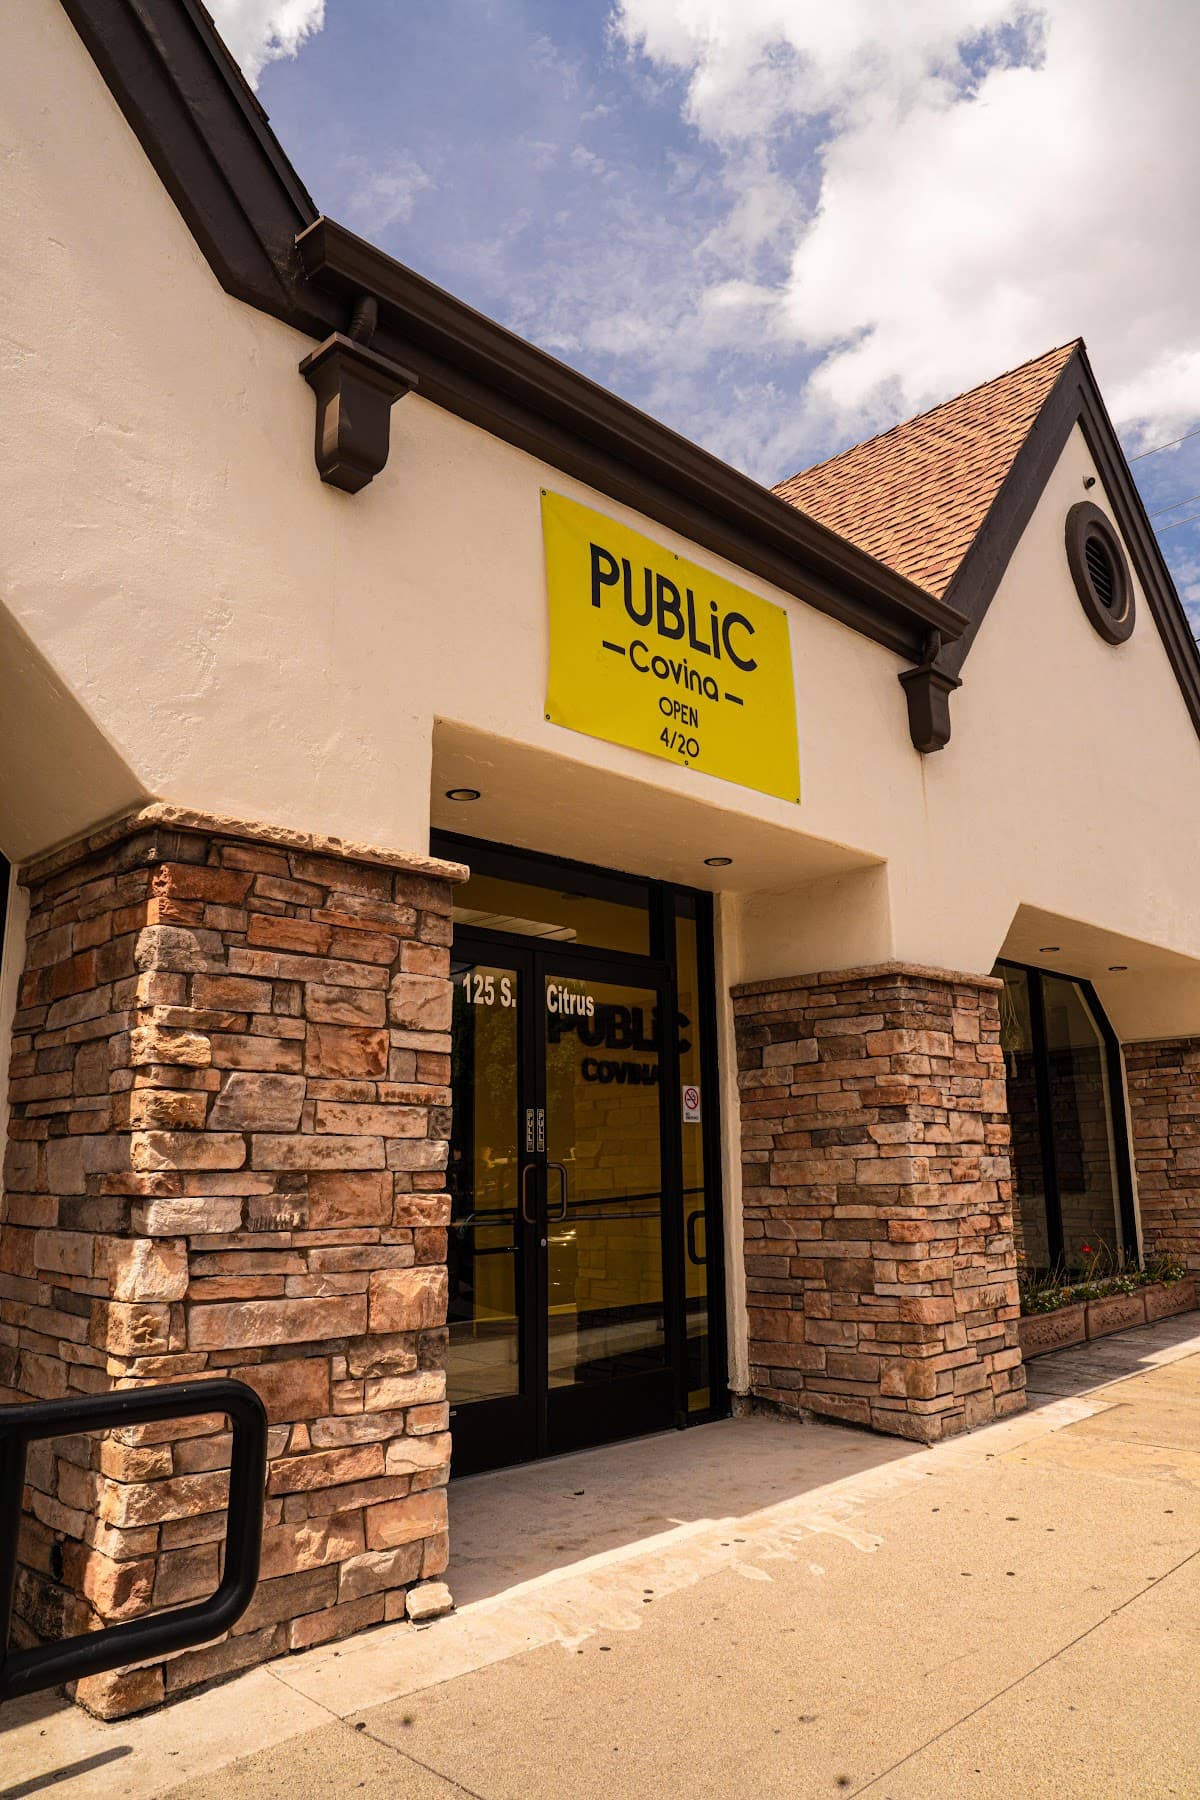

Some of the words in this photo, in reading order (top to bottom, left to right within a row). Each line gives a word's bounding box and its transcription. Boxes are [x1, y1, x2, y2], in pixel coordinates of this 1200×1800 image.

[659, 697, 698, 728] OPEN
[660, 727, 699, 757] 4/20
[463, 973, 495, 1005] 125
[500, 977, 517, 1007] S.
[546, 984, 595, 1016] Citrus
